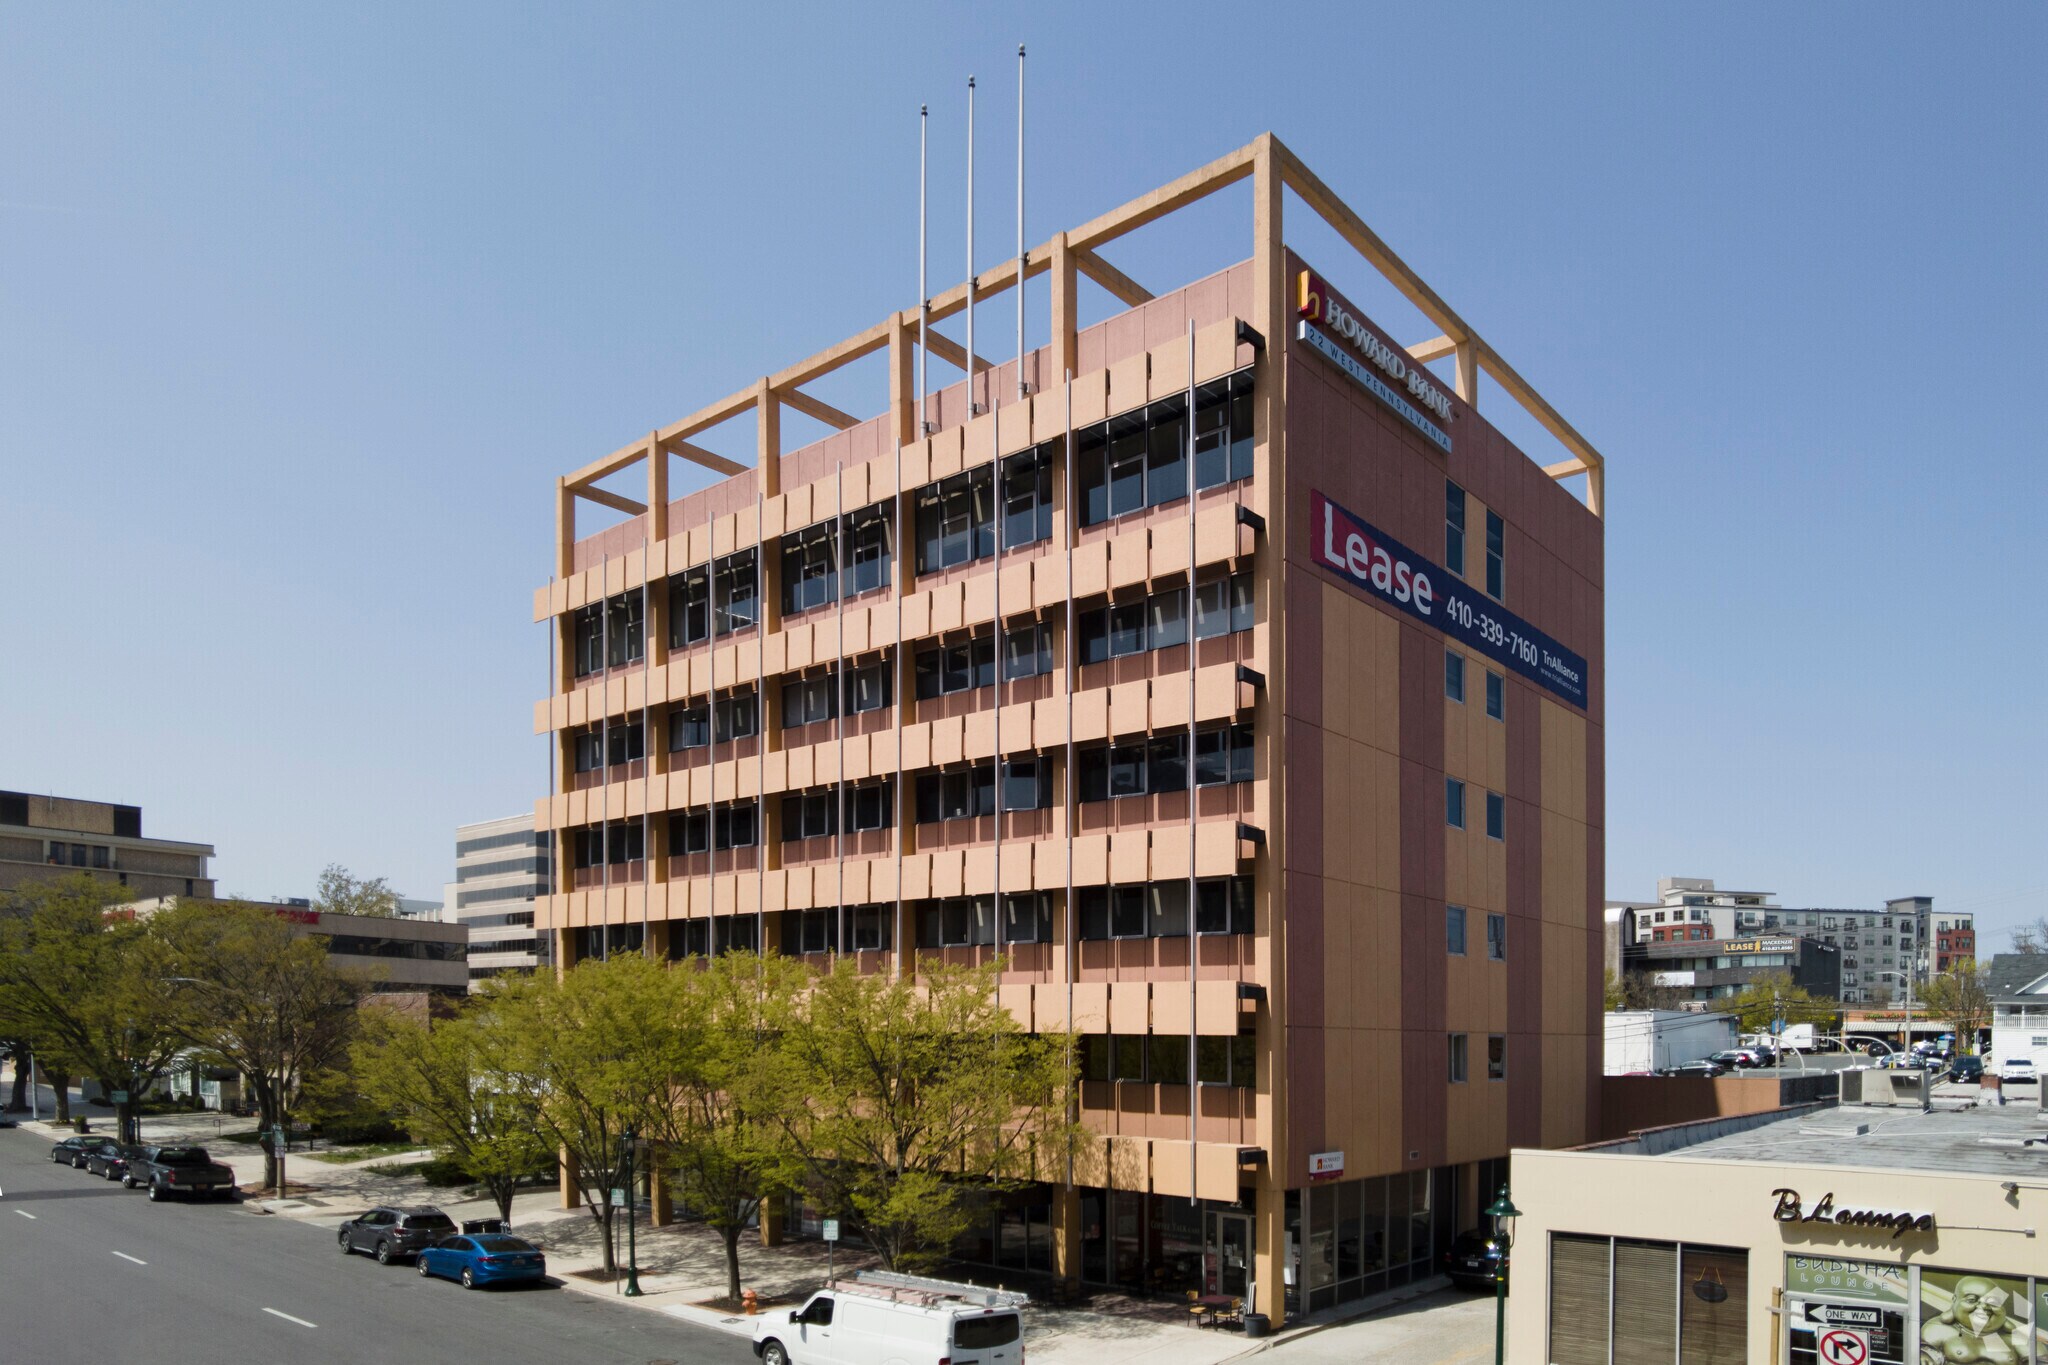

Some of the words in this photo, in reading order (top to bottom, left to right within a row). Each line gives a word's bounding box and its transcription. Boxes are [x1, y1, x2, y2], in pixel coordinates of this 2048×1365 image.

[1325, 296, 1406, 379] HOWARD
[1407, 369, 1453, 423] BANK
[1309, 328, 1324, 349] 22
[1330, 345, 1360, 377] WEST
[1366, 373, 1448, 449] PENNSYLVANIA
[1324, 500, 1433, 615] Lease
[1446, 596, 1538, 667] 410-339-7160
[1542, 650, 1579, 683] TriAlliance
[1725, 943, 1754, 951] LEASE
[1802, 1192, 1934, 1240] Lounge
[1794, 1257, 1900, 1280] BUDDHA
[1800, 1273, 1889, 1291] LOUNGE
[1825, 1310, 1846, 1319] ONE
[1851, 1311, 1873, 1321] WAY
